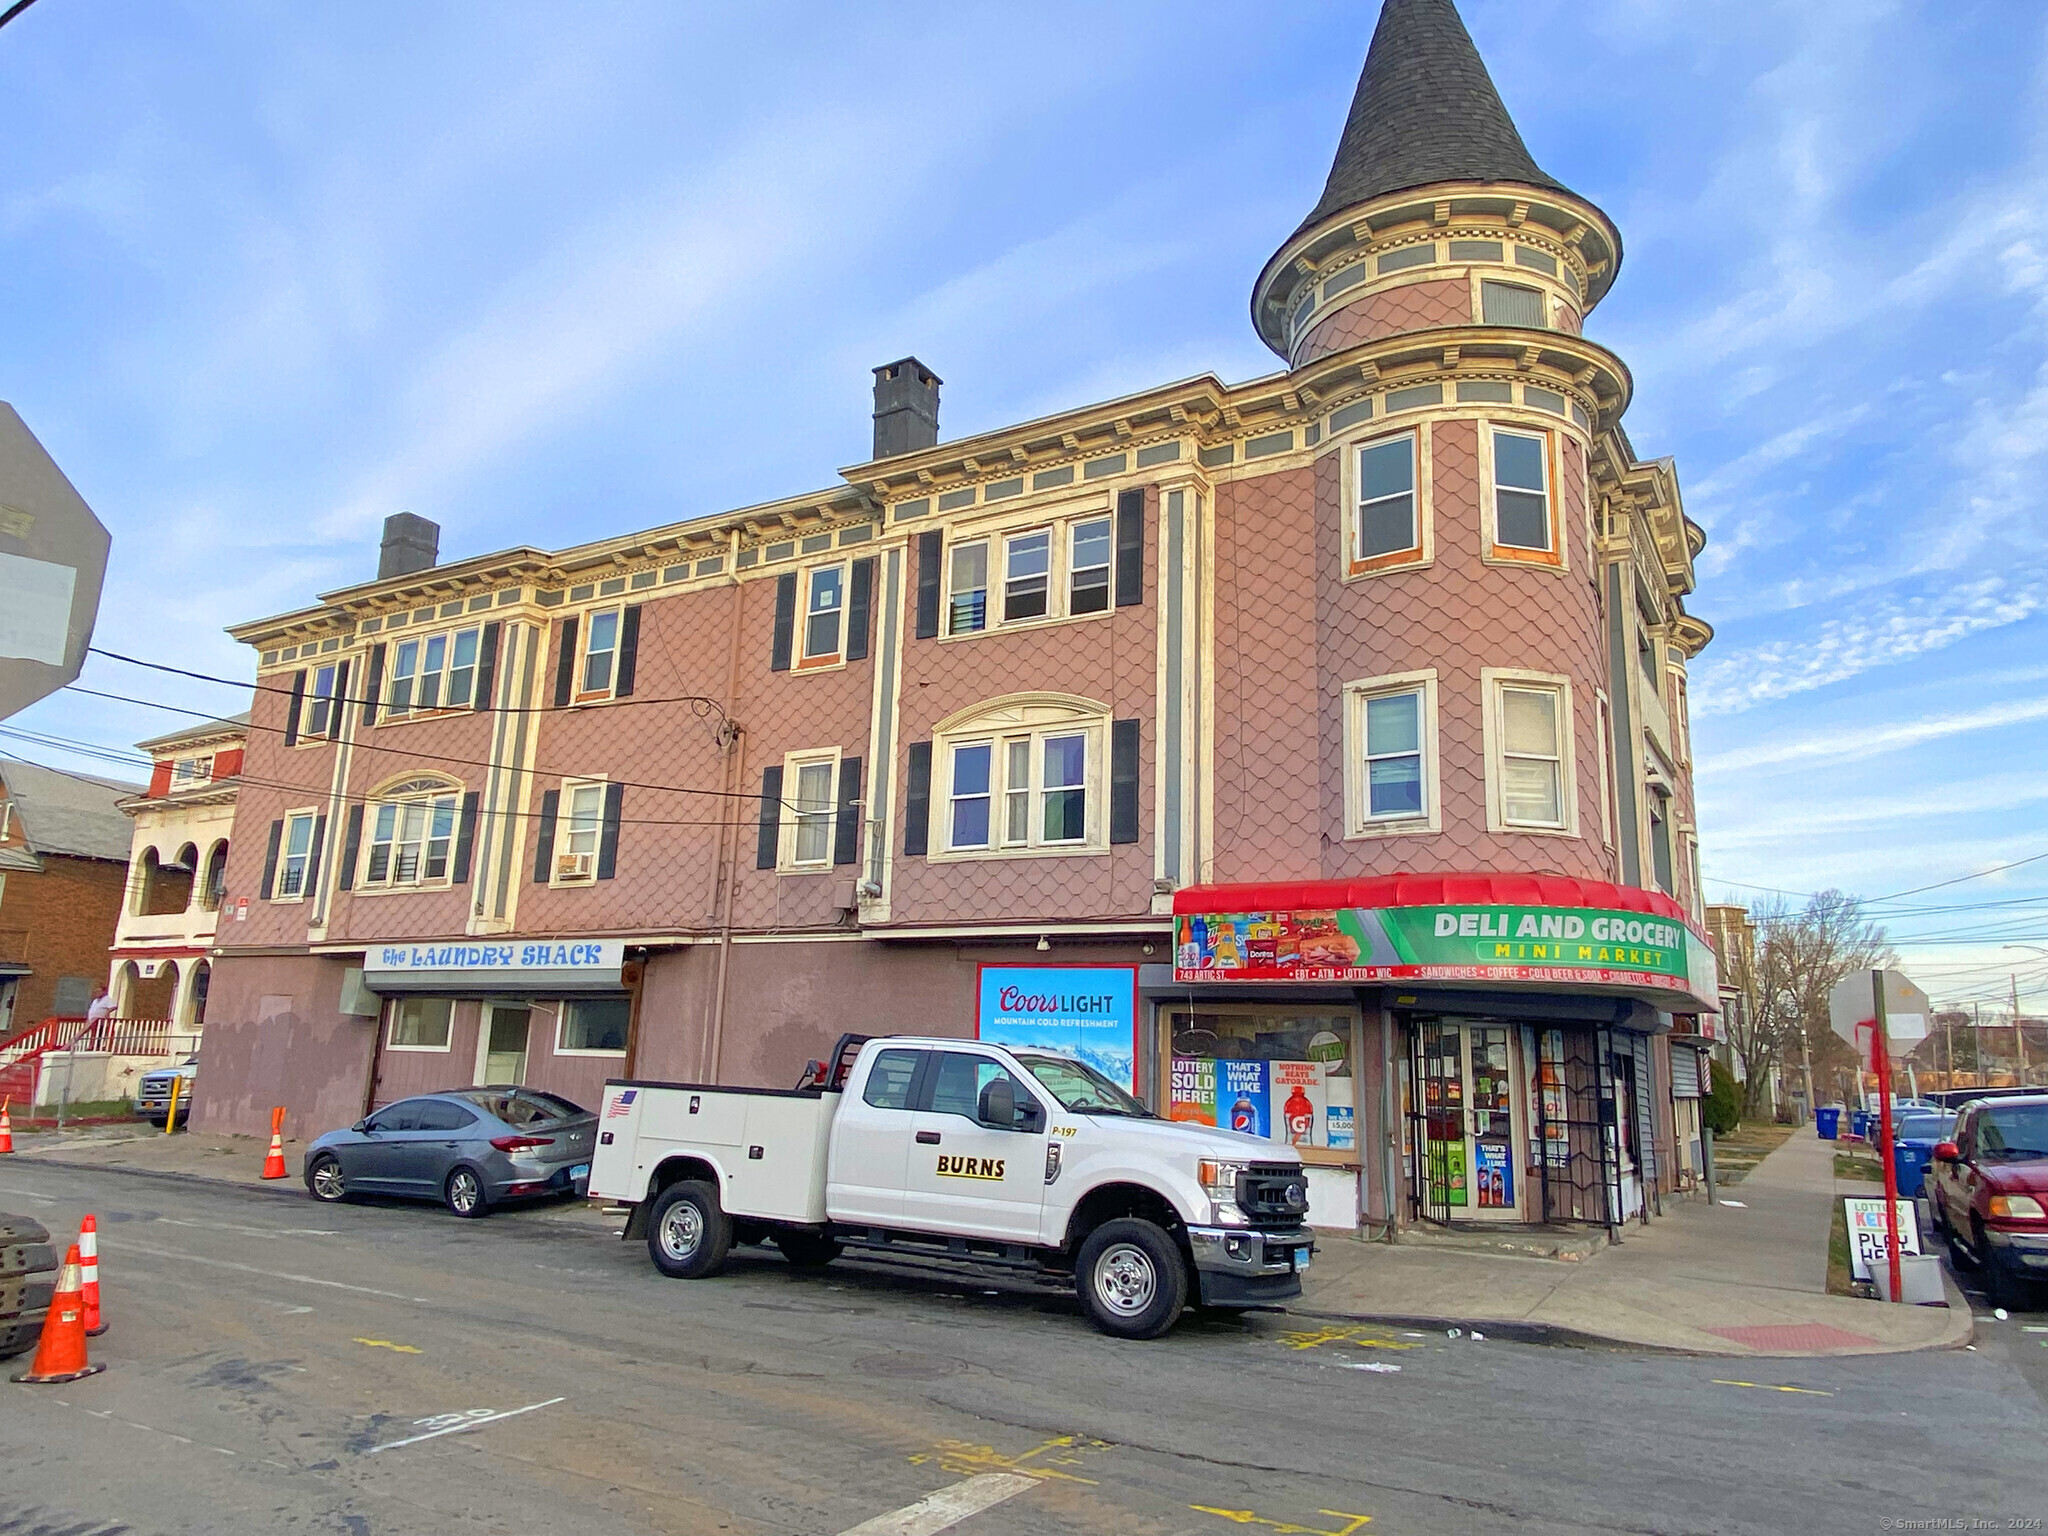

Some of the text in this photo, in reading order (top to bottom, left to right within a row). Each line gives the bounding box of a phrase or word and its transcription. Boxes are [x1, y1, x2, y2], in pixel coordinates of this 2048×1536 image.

[1434, 913, 1681, 950] DELI AND GROCERY
[382, 944, 602, 967] the LAUNDRY SHACK
[1250, 950, 1274, 958] Doritos
[1495, 943, 1662, 965] MINI MARKET
[1179, 970, 1194, 979] 743
[1194, 970, 1215, 979] ARTIC
[1295, 967, 1392, 979] EBT ATM LOTTO WIC
[1420, 966, 1478, 978] SANDWICHES
[1487, 967, 1519, 979] COFFEE
[1528, 968, 1550, 979] COLD
[1552, 968, 1573, 980] BEER
[1575, 969, 1582, 980] &
[1582, 969, 1603, 981] SODA
[1000, 985, 1113, 1013] Coors LIGHT
[994, 1017, 1119, 1028] MOUNTAIN COLD REFRESHMENT
[1172, 1061, 1214, 1074] LOTTERY
[1226, 1062, 1261, 1072] THAT'S
[1279, 1063, 1316, 1072] NOTHING
[1171, 1073, 1214, 1090] SOLD
[1227, 1072, 1261, 1082] WHAT
[1275, 1077, 1320, 1086] GATORADE.
[1227, 1081, 1261, 1094] I LIKE
[1172, 1089, 1215, 1104] HERE!
[1292, 1116, 1305, 1132] G
[1052, 1126, 1077, 1138] P-197
[1480, 1144, 1506, 1152] THAT'S
[1484, 1152, 1506, 1160] WHAT
[937, 1155, 1005, 1177] BURNS
[1854, 1203, 1904, 1213] LOTTY
